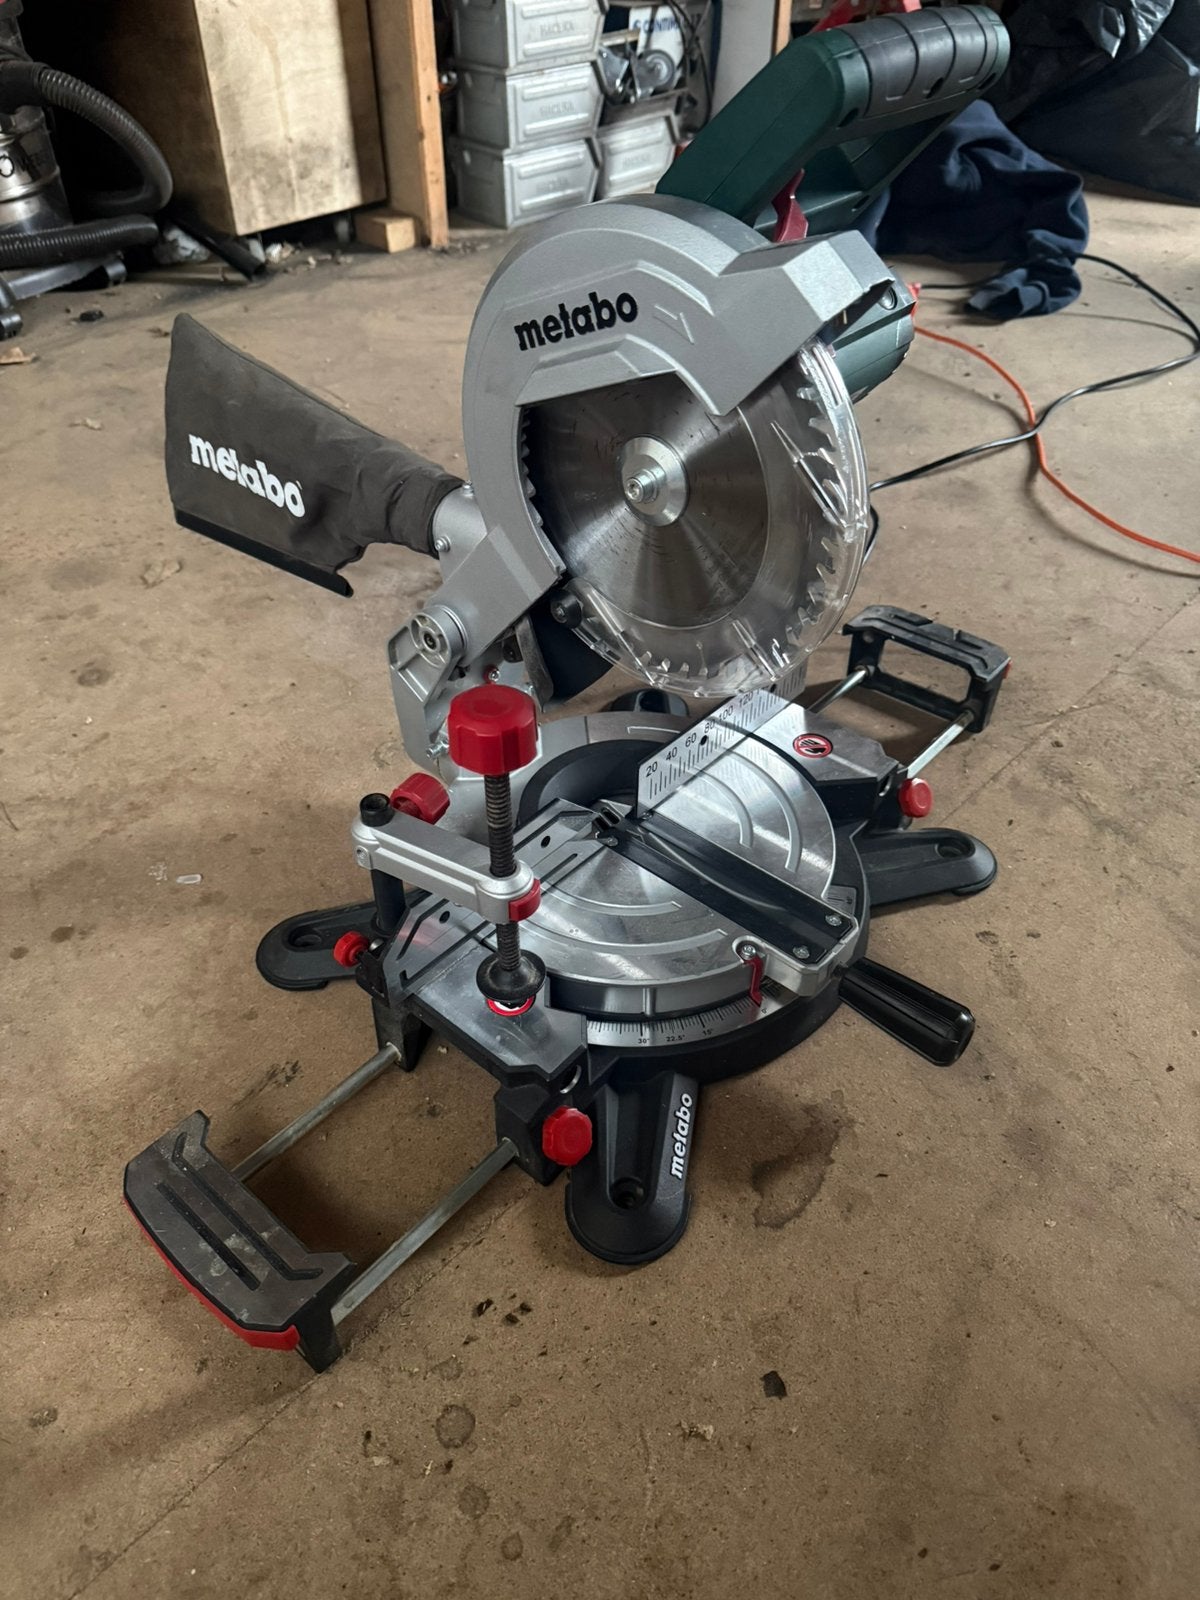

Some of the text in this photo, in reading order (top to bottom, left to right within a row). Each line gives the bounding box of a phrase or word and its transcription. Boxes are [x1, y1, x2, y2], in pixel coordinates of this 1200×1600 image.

[514, 291, 638, 351] metabo
[188, 434, 306, 518] metabo
[738, 691, 754, 708] 120
[718, 705, 734, 722] 100
[703, 719, 715, 734] 80
[685, 732, 697, 748] 60
[665, 746, 678, 761] 40
[645, 761, 658, 777] 20
[671, 1093, 693, 1179] metabo
